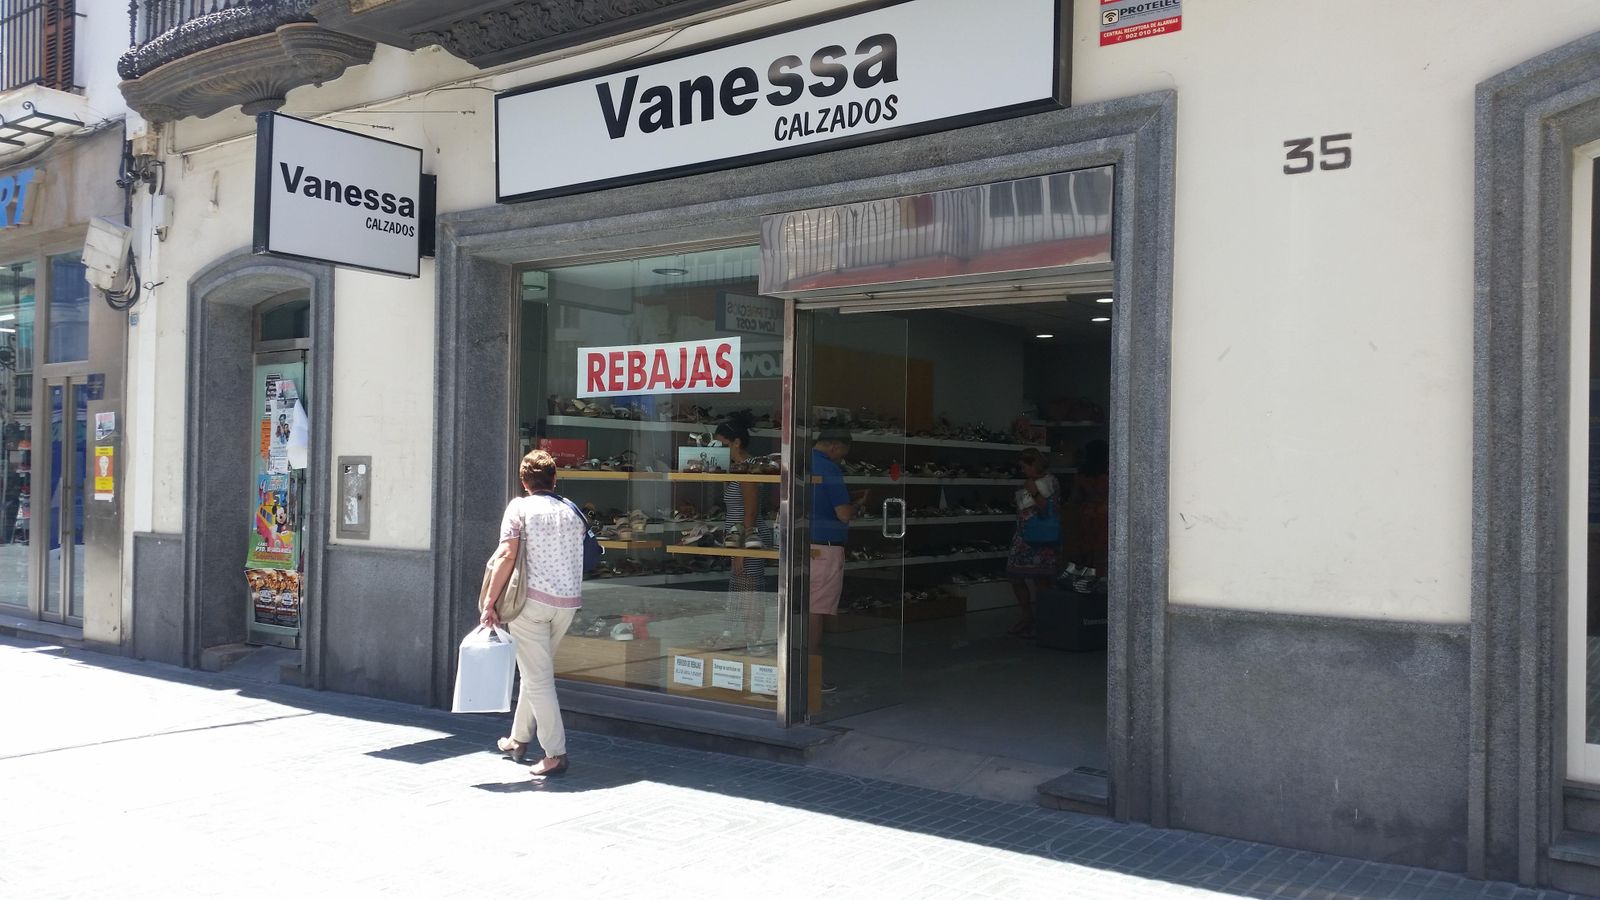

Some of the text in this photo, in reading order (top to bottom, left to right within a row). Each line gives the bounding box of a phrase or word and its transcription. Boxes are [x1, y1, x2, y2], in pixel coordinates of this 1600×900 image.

[1103, 30, 1123, 38] CENTRAL
[1124, 25, 1149, 34] RECEPTORA
[1157, 18, 1178, 27] ALARMAS
[595, 33, 899, 140] Vanessa
[774, 94, 898, 141] CALZADOS
[1283, 133, 1352, 175] 35
[280, 162, 415, 219] Vanessa
[365, 216, 415, 238] CALZADOS
[587, 343, 733, 392] REBAJAS
